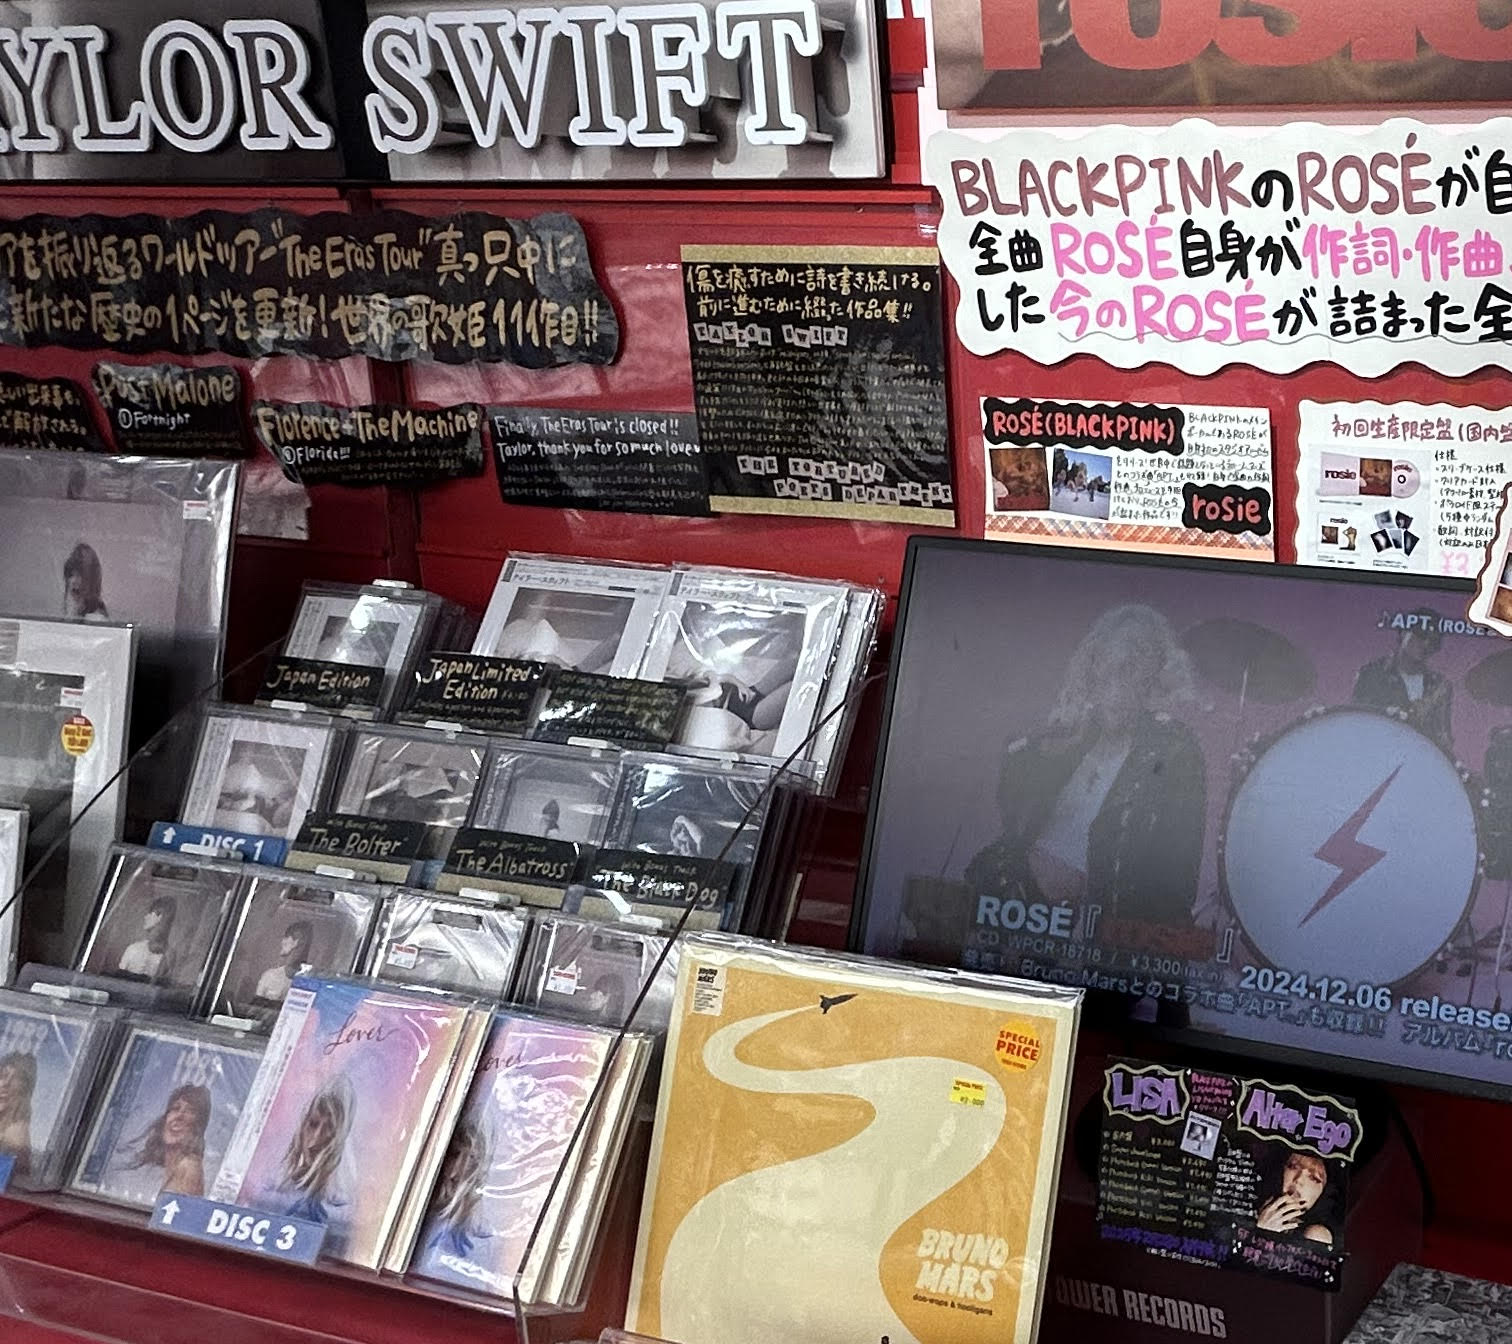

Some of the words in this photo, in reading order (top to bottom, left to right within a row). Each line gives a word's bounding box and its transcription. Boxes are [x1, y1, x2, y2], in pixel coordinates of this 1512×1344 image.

[0, 22, 333, 150] YLOR
[363, 1, 822, 154] SWIFT
[694, 322, 772, 347] TAYLOR
[782, 324, 848, 348] SWIFT
[152, 372, 235, 407] Malone
[737, 455, 778, 475] THE
[788, 457, 885, 484] TORTURED
[773, 478, 832, 501] POETS
[841, 482, 952, 506] DEPARTMENT
[1192, 493, 1262, 524] rosie
[266, 664, 317, 691] Japan
[317, 670, 371, 691] Edition
[472, 660, 531, 682] Limited
[443, 677, 498, 700] Edition
[976, 896, 1073, 938] ROSÉ
[976, 929, 1000, 947] CD
[1239, 965, 1392, 1012] 2024.12.06
[996, 1039, 1040, 1061] PRICE
[999, 1030, 1040, 1049] SPECIAL
[1111, 1071, 1181, 1117] LISA
[1303, 1105, 1351, 1154] Ego
[205, 1209, 271, 1245] DISC
[275, 1223, 297, 1251] 3
[917, 1228, 1009, 1269] BRUNO
[915, 1260, 994, 1302] MARS
[1122, 1288, 1228, 1339] RECORDS
